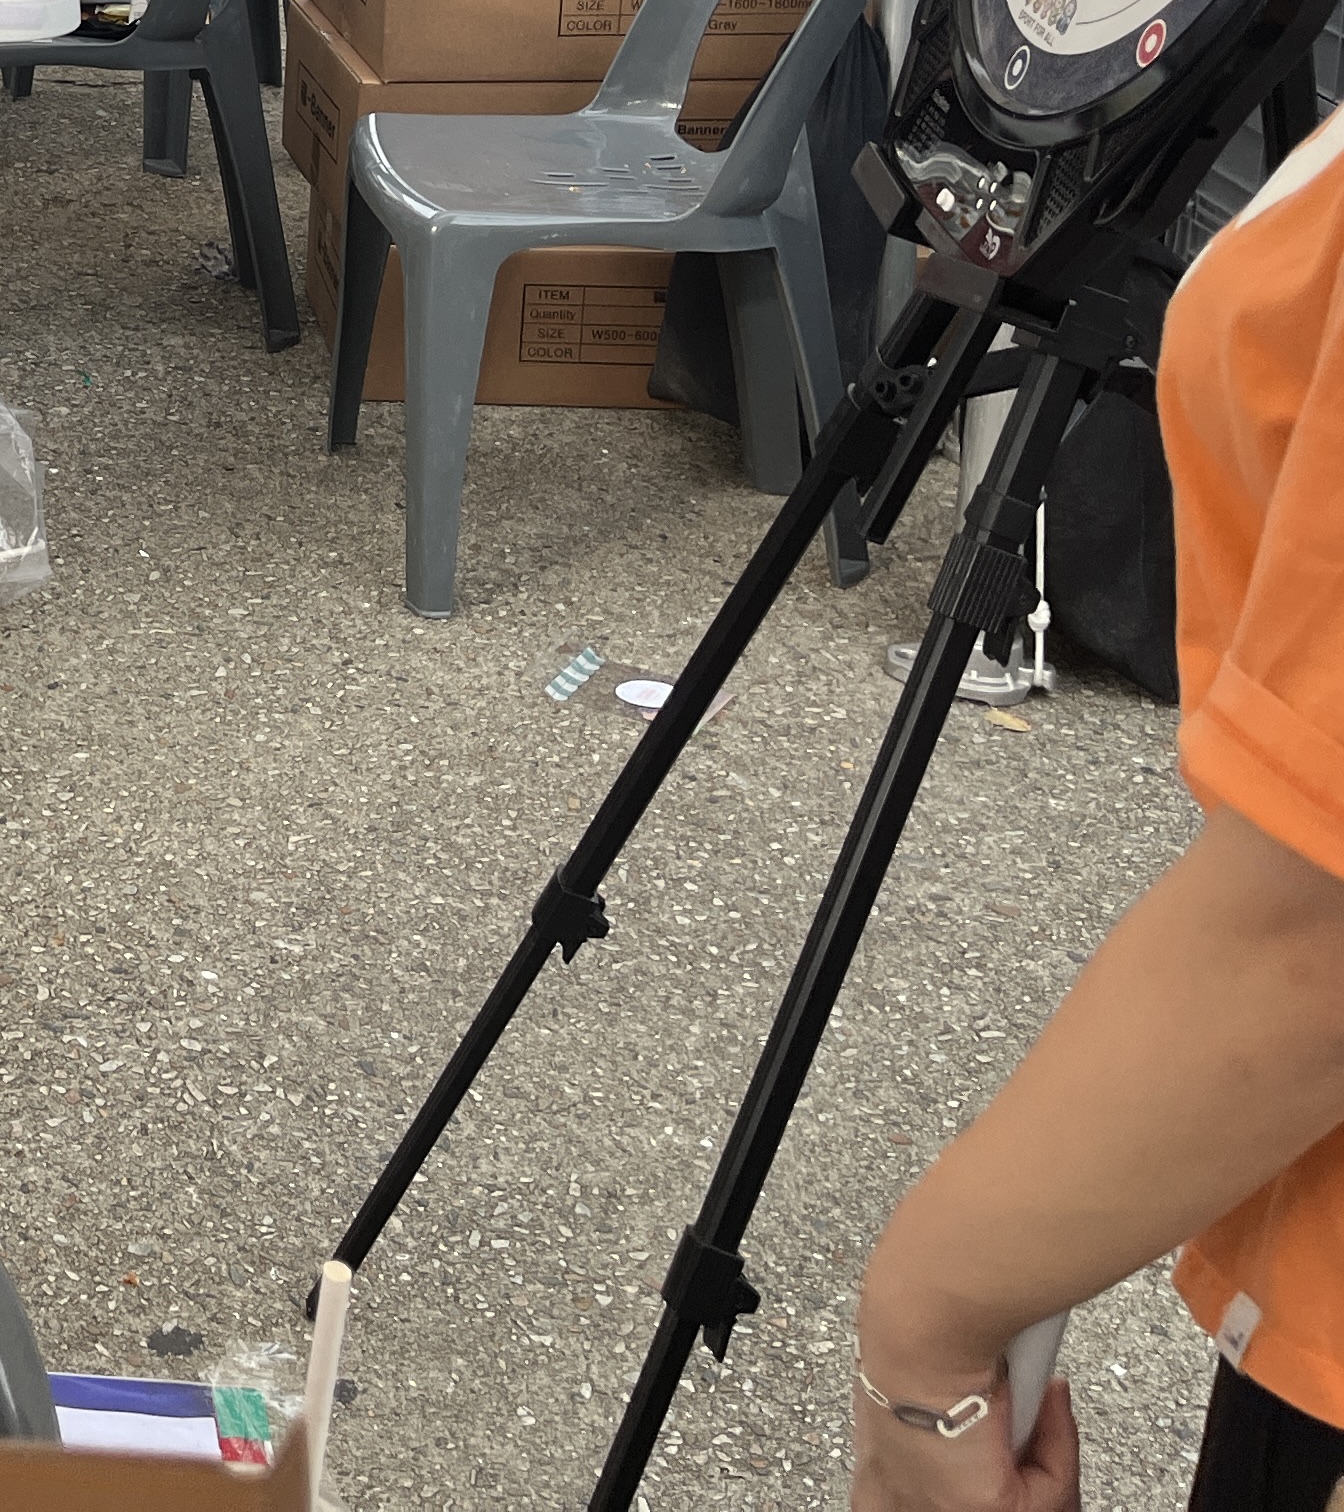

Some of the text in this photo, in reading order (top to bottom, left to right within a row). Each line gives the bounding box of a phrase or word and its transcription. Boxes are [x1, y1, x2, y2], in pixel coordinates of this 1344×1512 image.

[576, 0, 605, 10] SIZE
[566, 19, 738, 31] COLOR Gray
[538, 289, 570, 300] ITEM
[529, 308, 576, 321] Quantity
[538, 328, 565, 339] SIZE
[527, 347, 573, 359] COLOR
